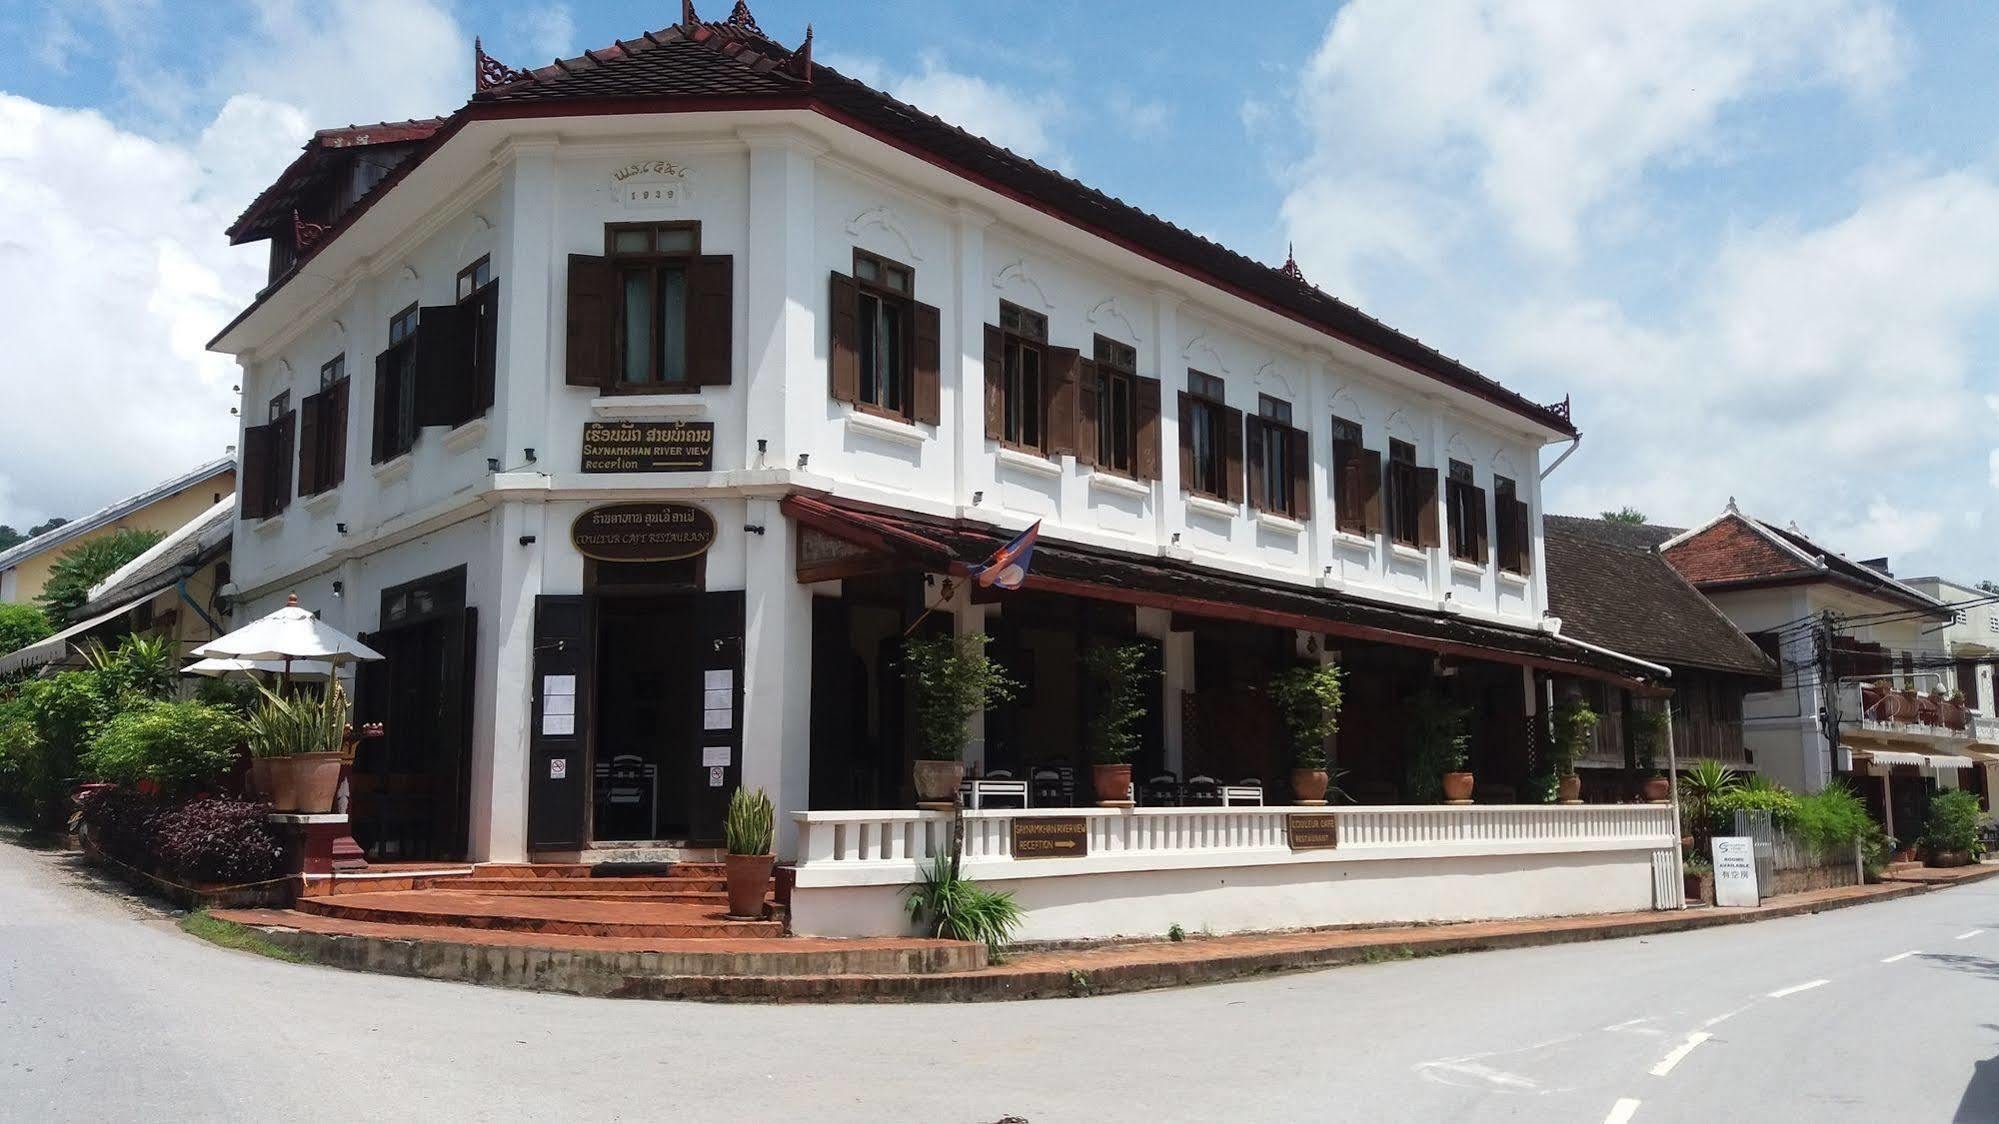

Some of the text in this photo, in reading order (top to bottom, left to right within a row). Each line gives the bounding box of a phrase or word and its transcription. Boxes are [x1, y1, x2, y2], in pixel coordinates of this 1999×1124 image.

[631, 190, 674, 200] 1939
[583, 444, 710, 456] SAYNAMKHAN RIVER VIEW
[649, 531, 710, 544] RESTAURANT
[1019, 840, 1054, 850] RECEPTION
